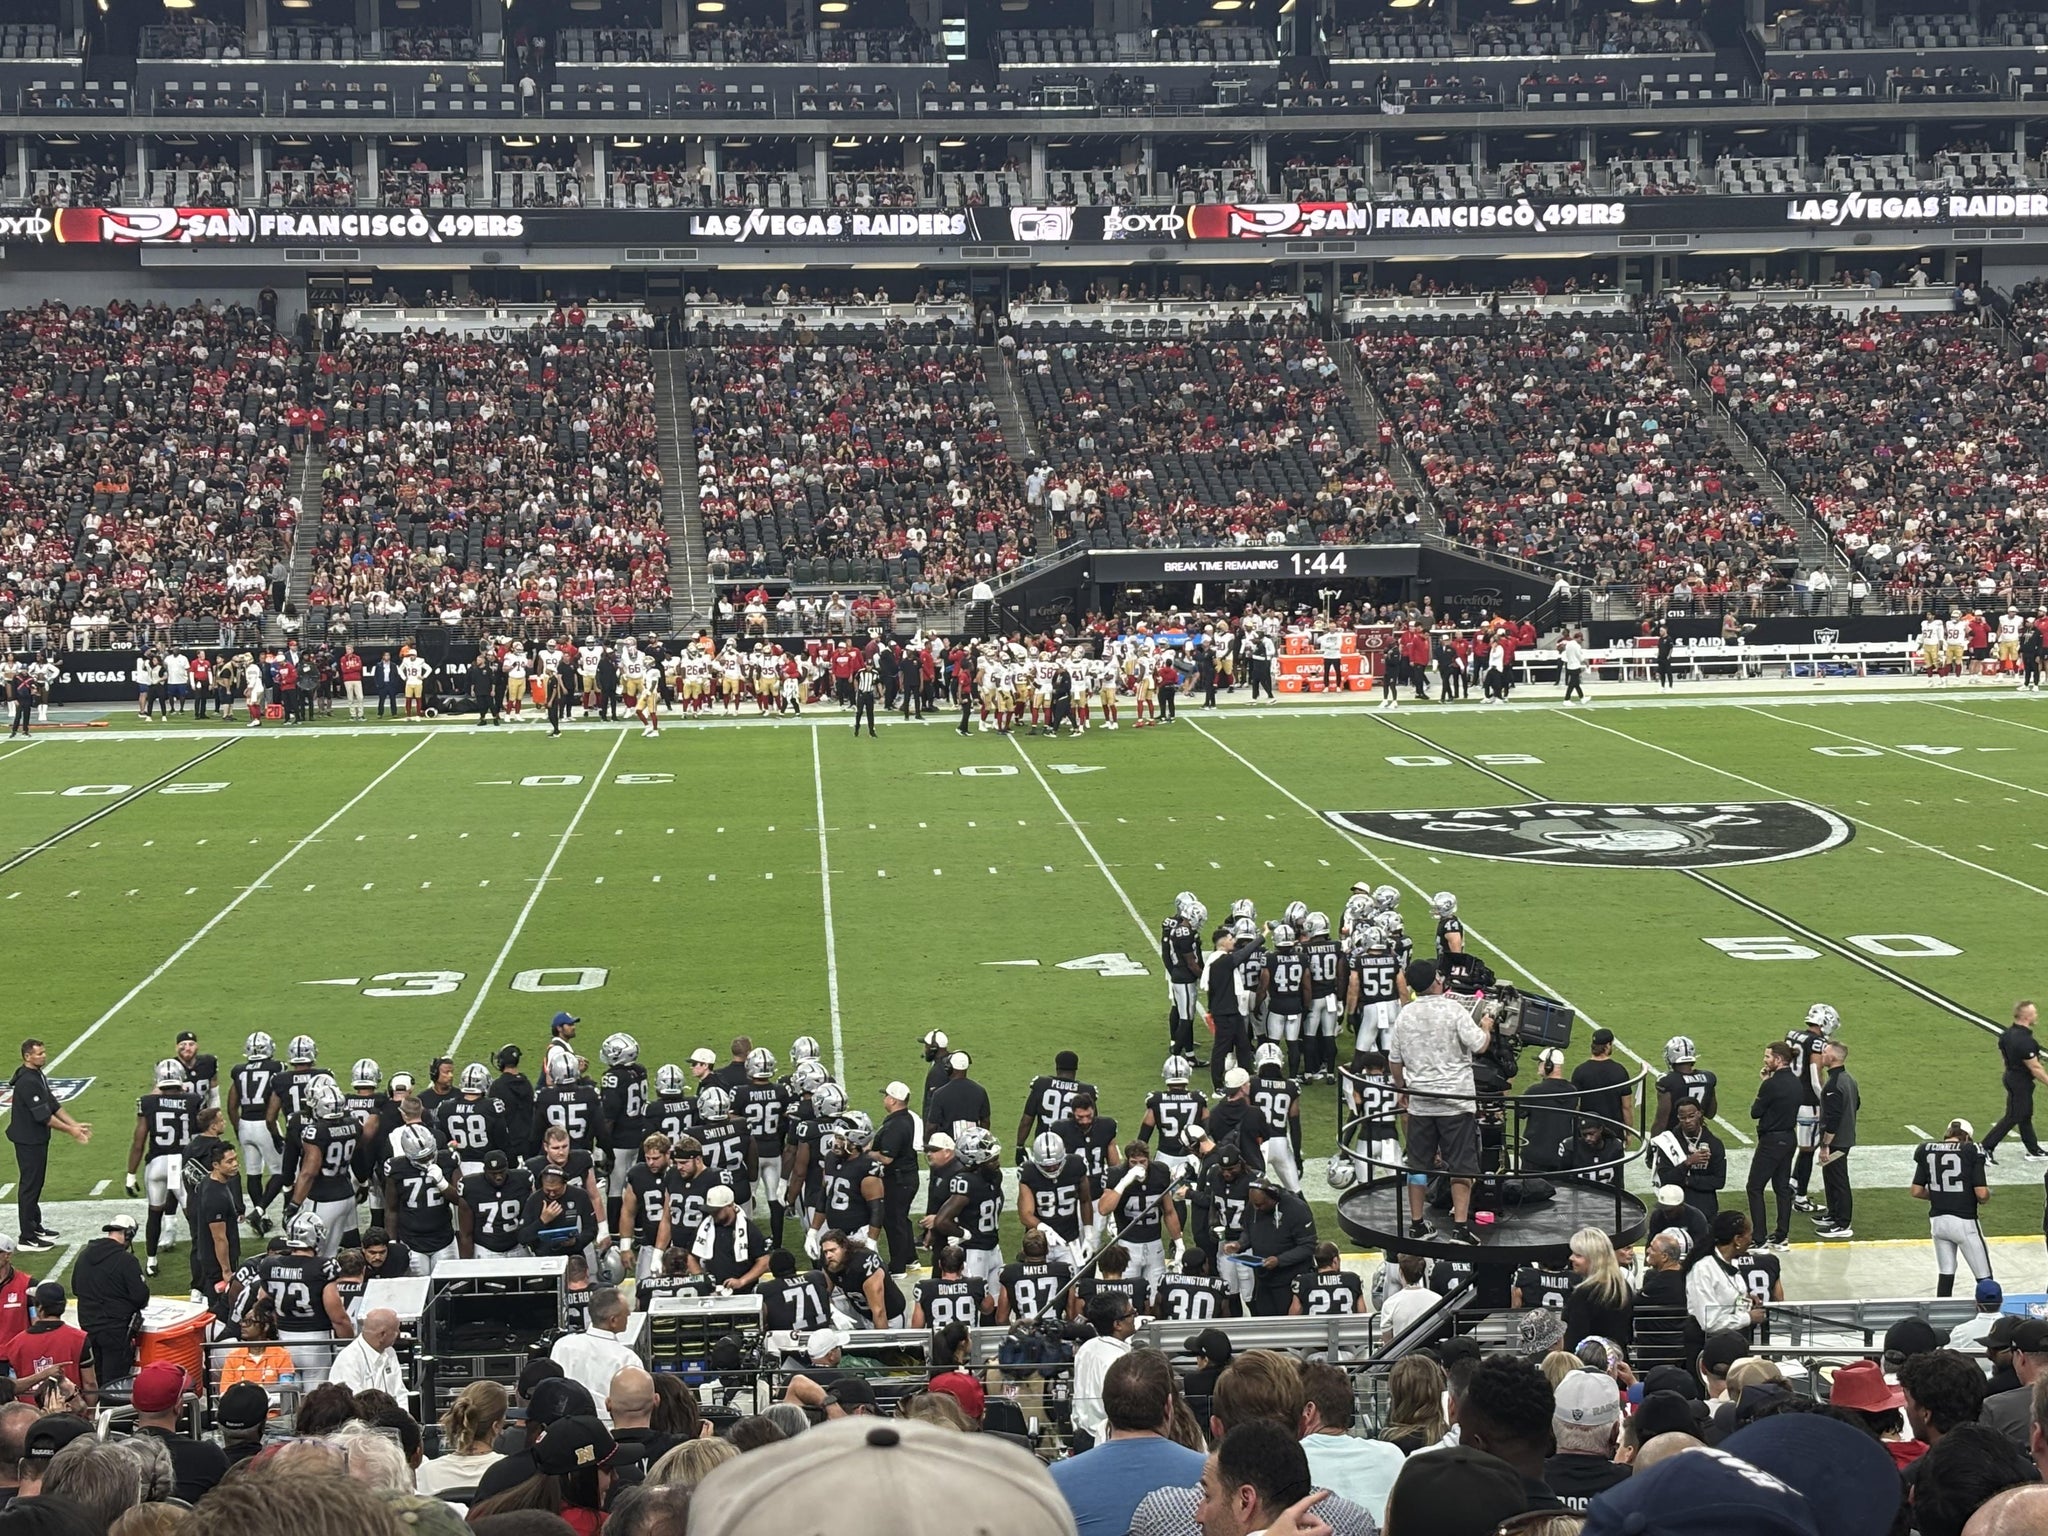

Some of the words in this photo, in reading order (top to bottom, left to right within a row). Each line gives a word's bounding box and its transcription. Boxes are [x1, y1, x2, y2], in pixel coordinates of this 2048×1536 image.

[1309, 208, 1365, 231] SAN
[1376, 205, 1529, 230] FRANCISCO
[1543, 203, 1625, 227] 49ERS
[1787, 200, 1837, 222] LAS
[1847, 198, 1937, 220] VEGAS
[1949, 195, 2048, 218] RAIDER
[189, 214, 250, 237] SAN
[260, 214, 429, 237] FRANCISCO
[437, 215, 524, 238] 49ERS
[689, 215, 741, 237] LAS
[752, 214, 842, 236] VEGAS
[853, 213, 967, 236] RAIDERS
[1164, 560, 1197, 572] BREAK
[1199, 560, 1222, 571] TIME
[1224, 559, 1279, 571] REMAINING
[1290, 551, 1348, 576] 1:44
[1667, 609, 1685, 618] C113
[112, 643, 133, 654] C109
[79, 670, 127, 684] VEGAS
[1296, 663, 1349, 674] GATOAE
[1274, 964, 1303, 992] 49
[1309, 953, 1337, 981] 40
[1362, 968, 1395, 996] 55
[239, 1070, 270, 1105] 17
[559, 1092, 576, 1101] PAYE
[750, 1088, 777, 1101] PORTER
[160, 1098, 187, 1109] KOONCE
[663, 1100, 690, 1113] STUKES
[1254, 1091, 1291, 1129] 39
[1363, 1087, 1397, 1122] 22
[155, 1112, 191, 1146] 51
[446, 1114, 489, 1149] 68
[546, 1103, 588, 1139] 95
[744, 1101, 782, 1136] 26
[1158, 1102, 1199, 1138] 57
[703, 1126, 727, 1140] SMITH
[322, 1138, 357, 1177] 99
[701, 1136, 745, 1171] 75
[1926, 1153, 1964, 1193] 12
[403, 1176, 444, 1209] 72
[478, 1199, 521, 1234] 79
[670, 1193, 704, 1228] 66
[1124, 1194, 1160, 1225] 45
[271, 1266, 303, 1280] HENNING
[1023, 1264, 1047, 1276] MAYER
[1165, 1274, 1209, 1288] WASHINGTON
[1317, 1275, 1343, 1286] LAUBE
[1540, 1275, 1569, 1289] NAILOR
[266, 1281, 315, 1318] 73
[937, 1282, 969, 1296] BOWERS
[1013, 1277, 1059, 1320] 87
[1308, 1287, 1354, 1316] 23
[782, 1284, 828, 1331] 71
[930, 1295, 977, 1331] 89
[1167, 1288, 1215, 1320] 30
